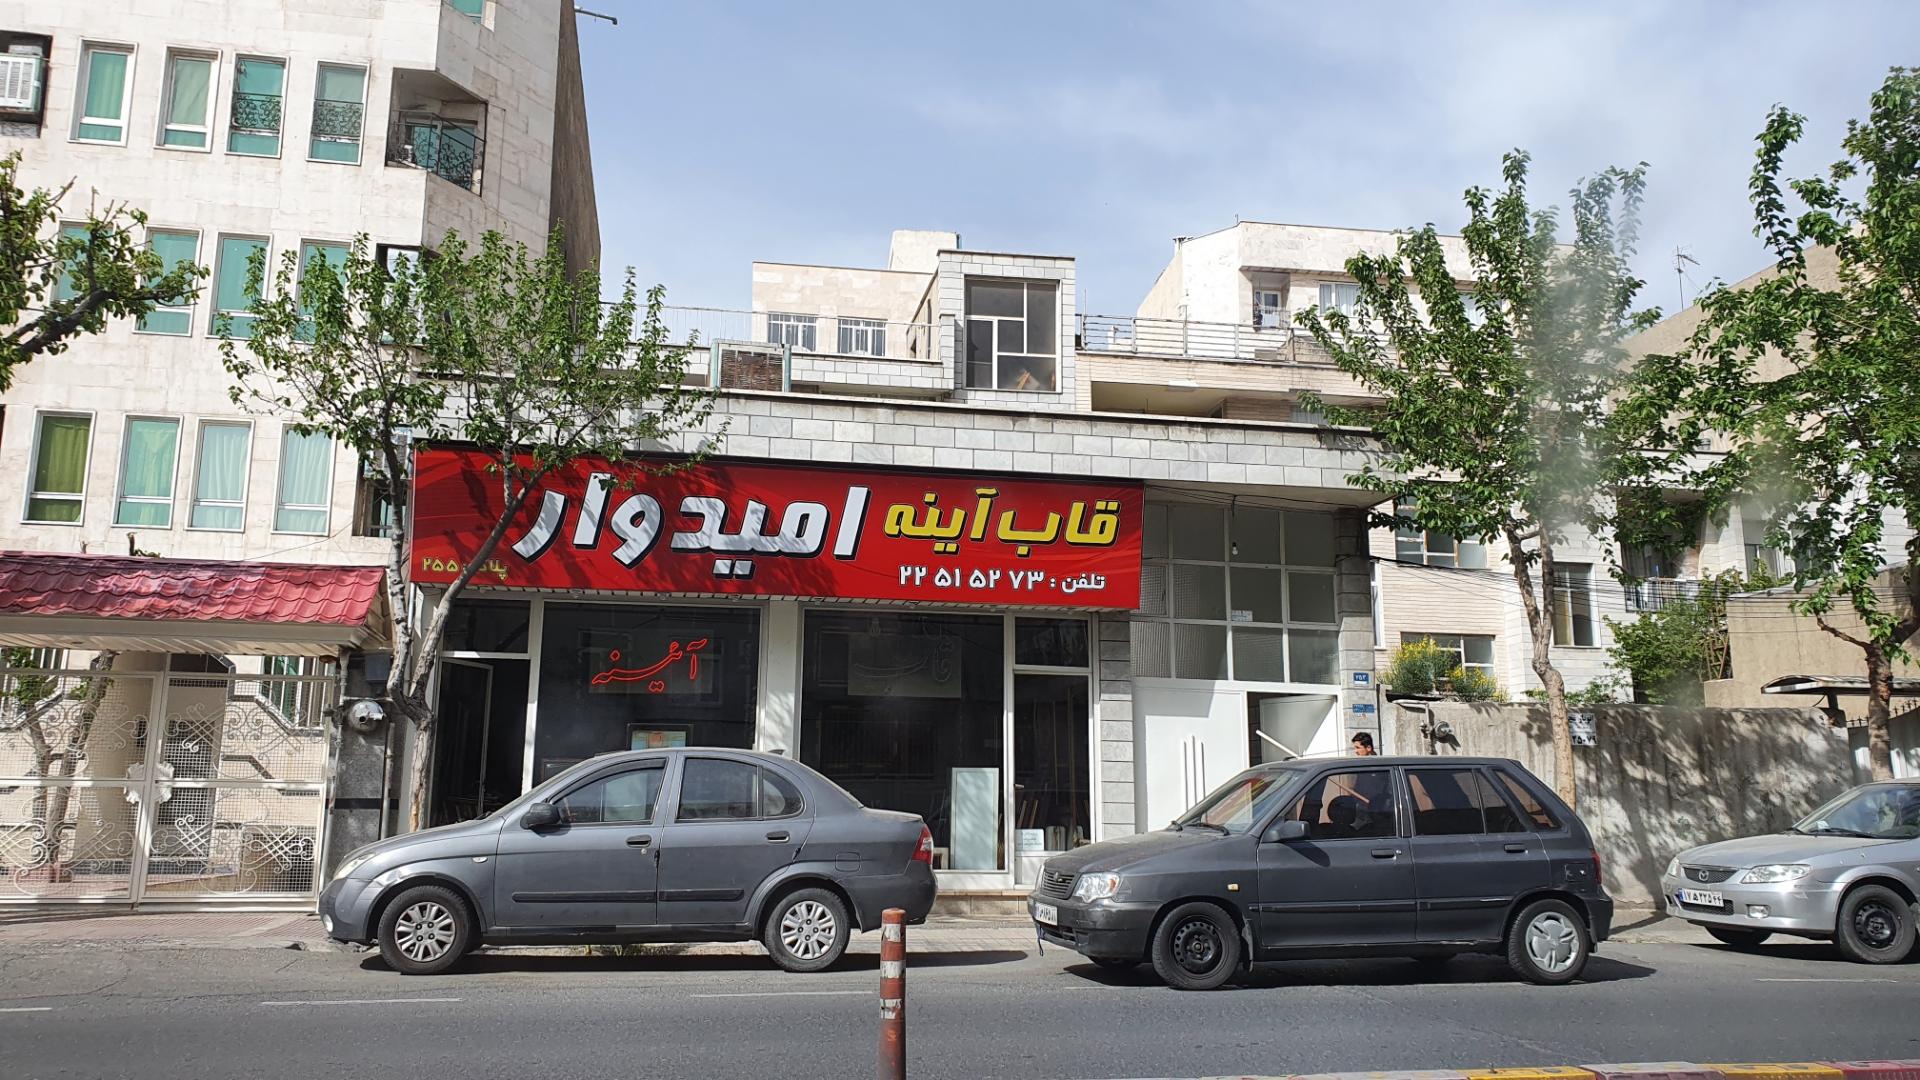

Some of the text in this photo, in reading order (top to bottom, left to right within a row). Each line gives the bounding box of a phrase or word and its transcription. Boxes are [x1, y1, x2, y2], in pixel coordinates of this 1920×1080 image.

[512, 472, 871, 579] امیدوار
[884, 487, 1121, 557] قاب آینه
[423, 558, 459, 572] ۲۵۵
[899, 565, 927, 586] ۲۲
[934, 567, 962, 588] ۵۱
[969, 569, 1001, 589] ۵۲
[1009, 570, 1045, 590] ۷۳
